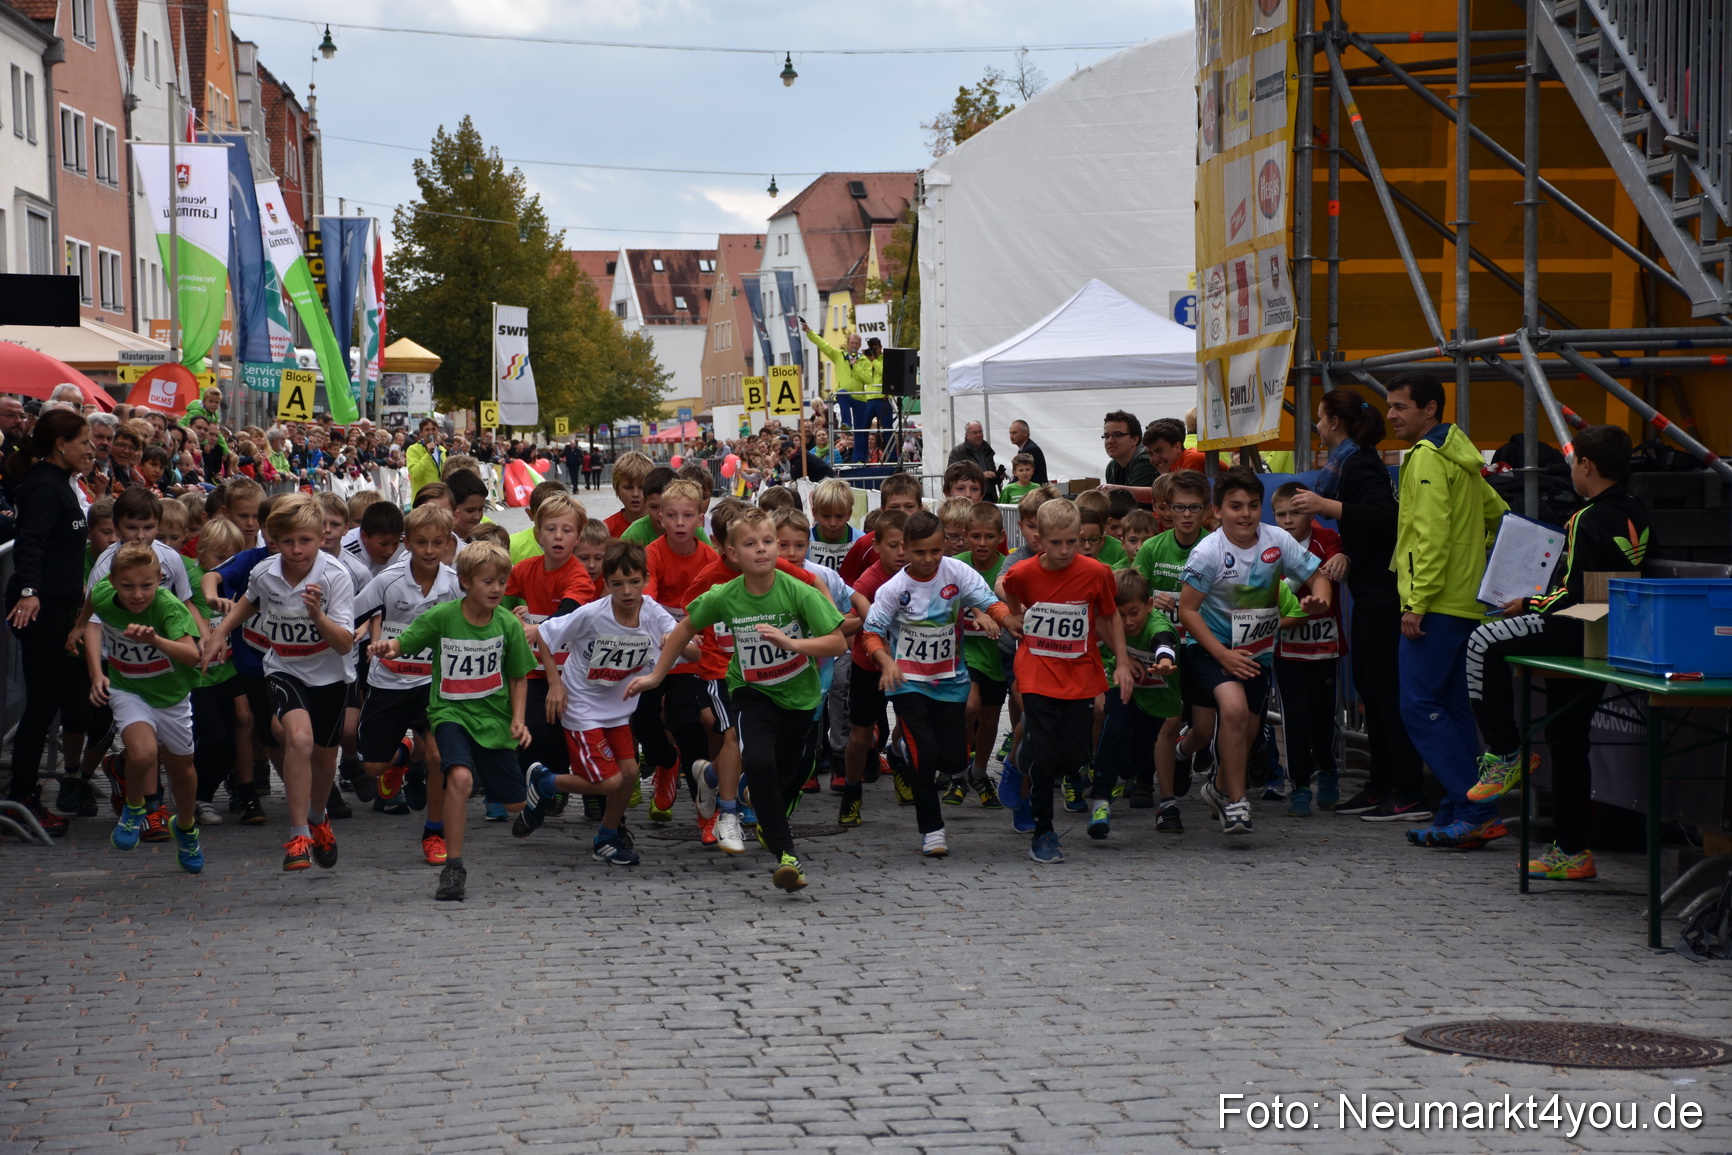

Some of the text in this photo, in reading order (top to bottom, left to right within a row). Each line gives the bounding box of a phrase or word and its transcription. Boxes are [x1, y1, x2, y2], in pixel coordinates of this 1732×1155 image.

[122, 352, 165, 362] Klostergasse
[285, 371, 313, 383] Block
[772, 367, 798, 377] Block
[150, 394, 173, 406] DKMS
[286, 386, 305, 411] A
[749, 387, 761, 404] B
[777, 381, 796, 405] A
[1230, 384, 1247, 407] swn
[485, 409, 494, 422] C
[558, 423, 566, 433] D
[732, 613, 776, 624] Neumarkter
[1050, 608, 1080, 616] Neumarkt
[267, 620, 323, 642] 7028
[900, 627, 919, 637] PARTL
[1031, 615, 1084, 638] 7169
[1239, 618, 1279, 643] 7409
[108, 636, 161, 662] 7212
[443, 644, 463, 652] PARTL
[904, 637, 951, 661] 7413
[447, 652, 497, 676] 7418
[599, 648, 648, 668] 7417
[398, 664, 423, 673] Lukas
[757, 661, 798, 679] Benjamin
